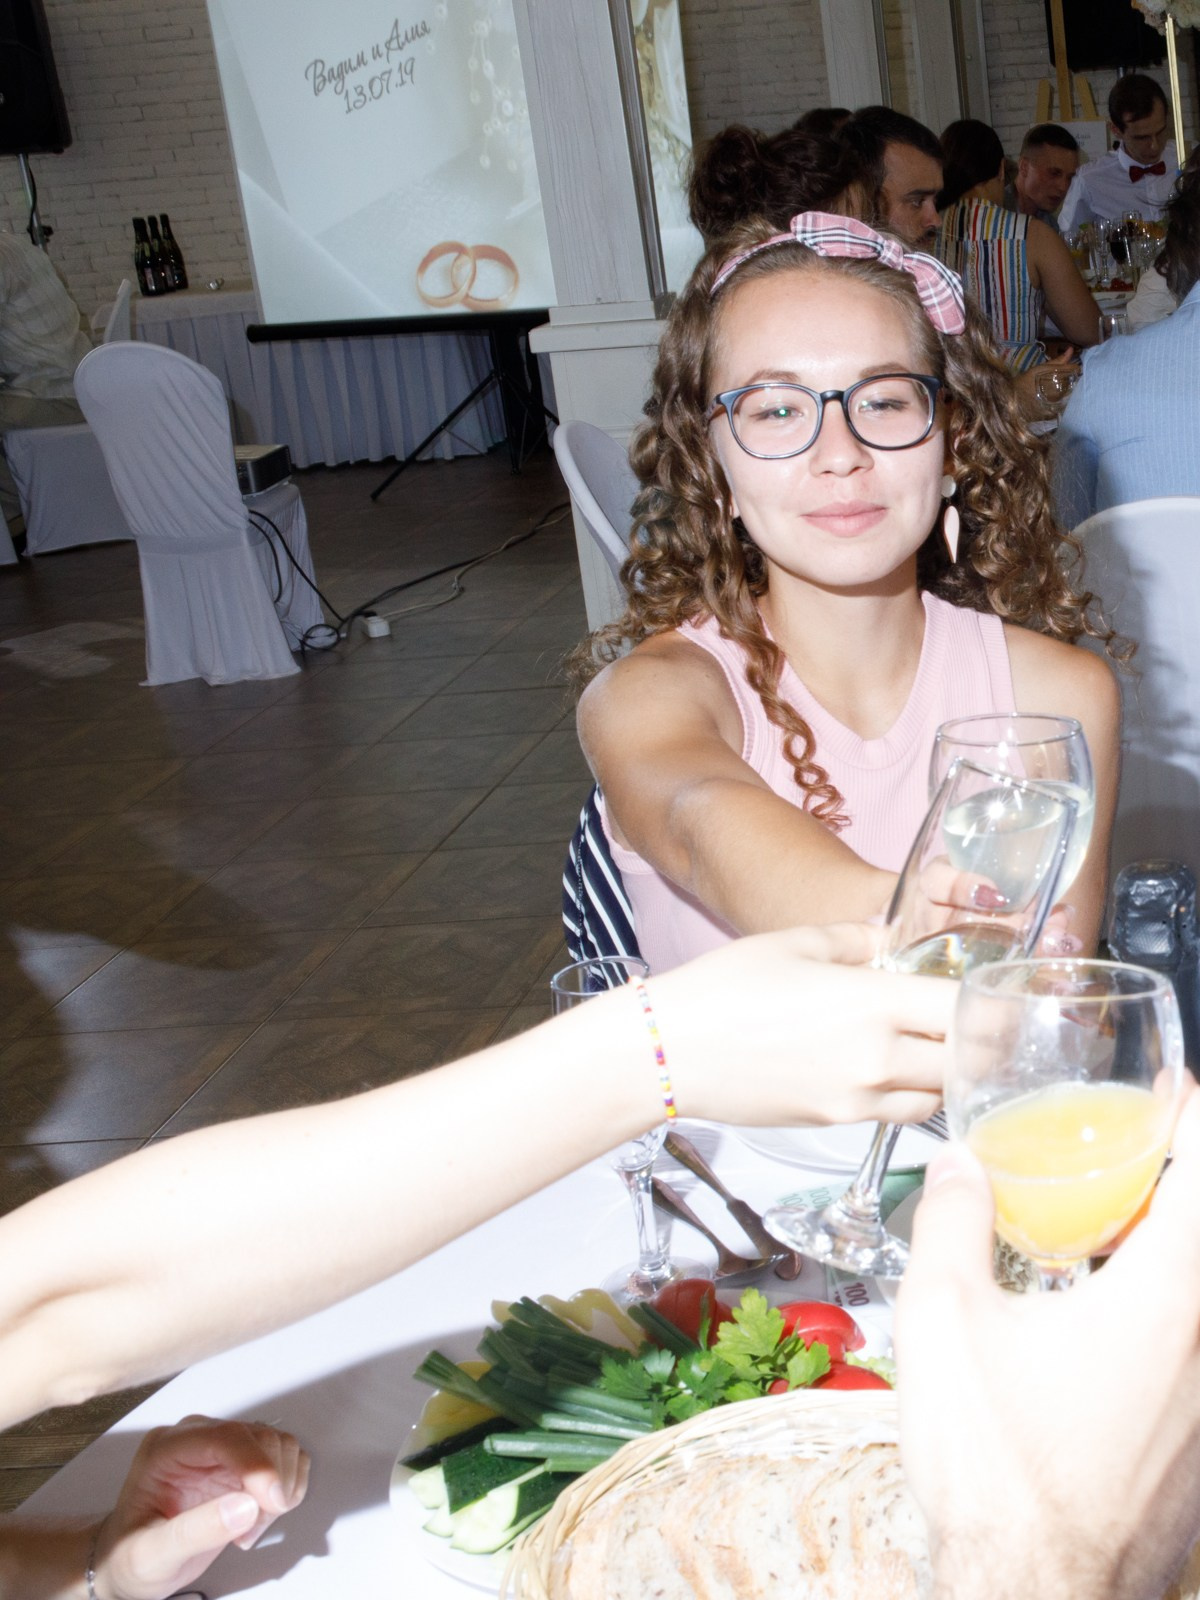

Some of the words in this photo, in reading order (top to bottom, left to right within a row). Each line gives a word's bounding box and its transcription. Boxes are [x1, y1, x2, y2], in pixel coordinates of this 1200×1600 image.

[304, 50, 368, 97] Вадим
[371, 43, 384, 61] и
[384, 17, 432, 64] Алия
[343, 56, 416, 115] 13.07.19
[780, 1193, 808, 1208] 10
[843, 1281, 870, 1307] 100
